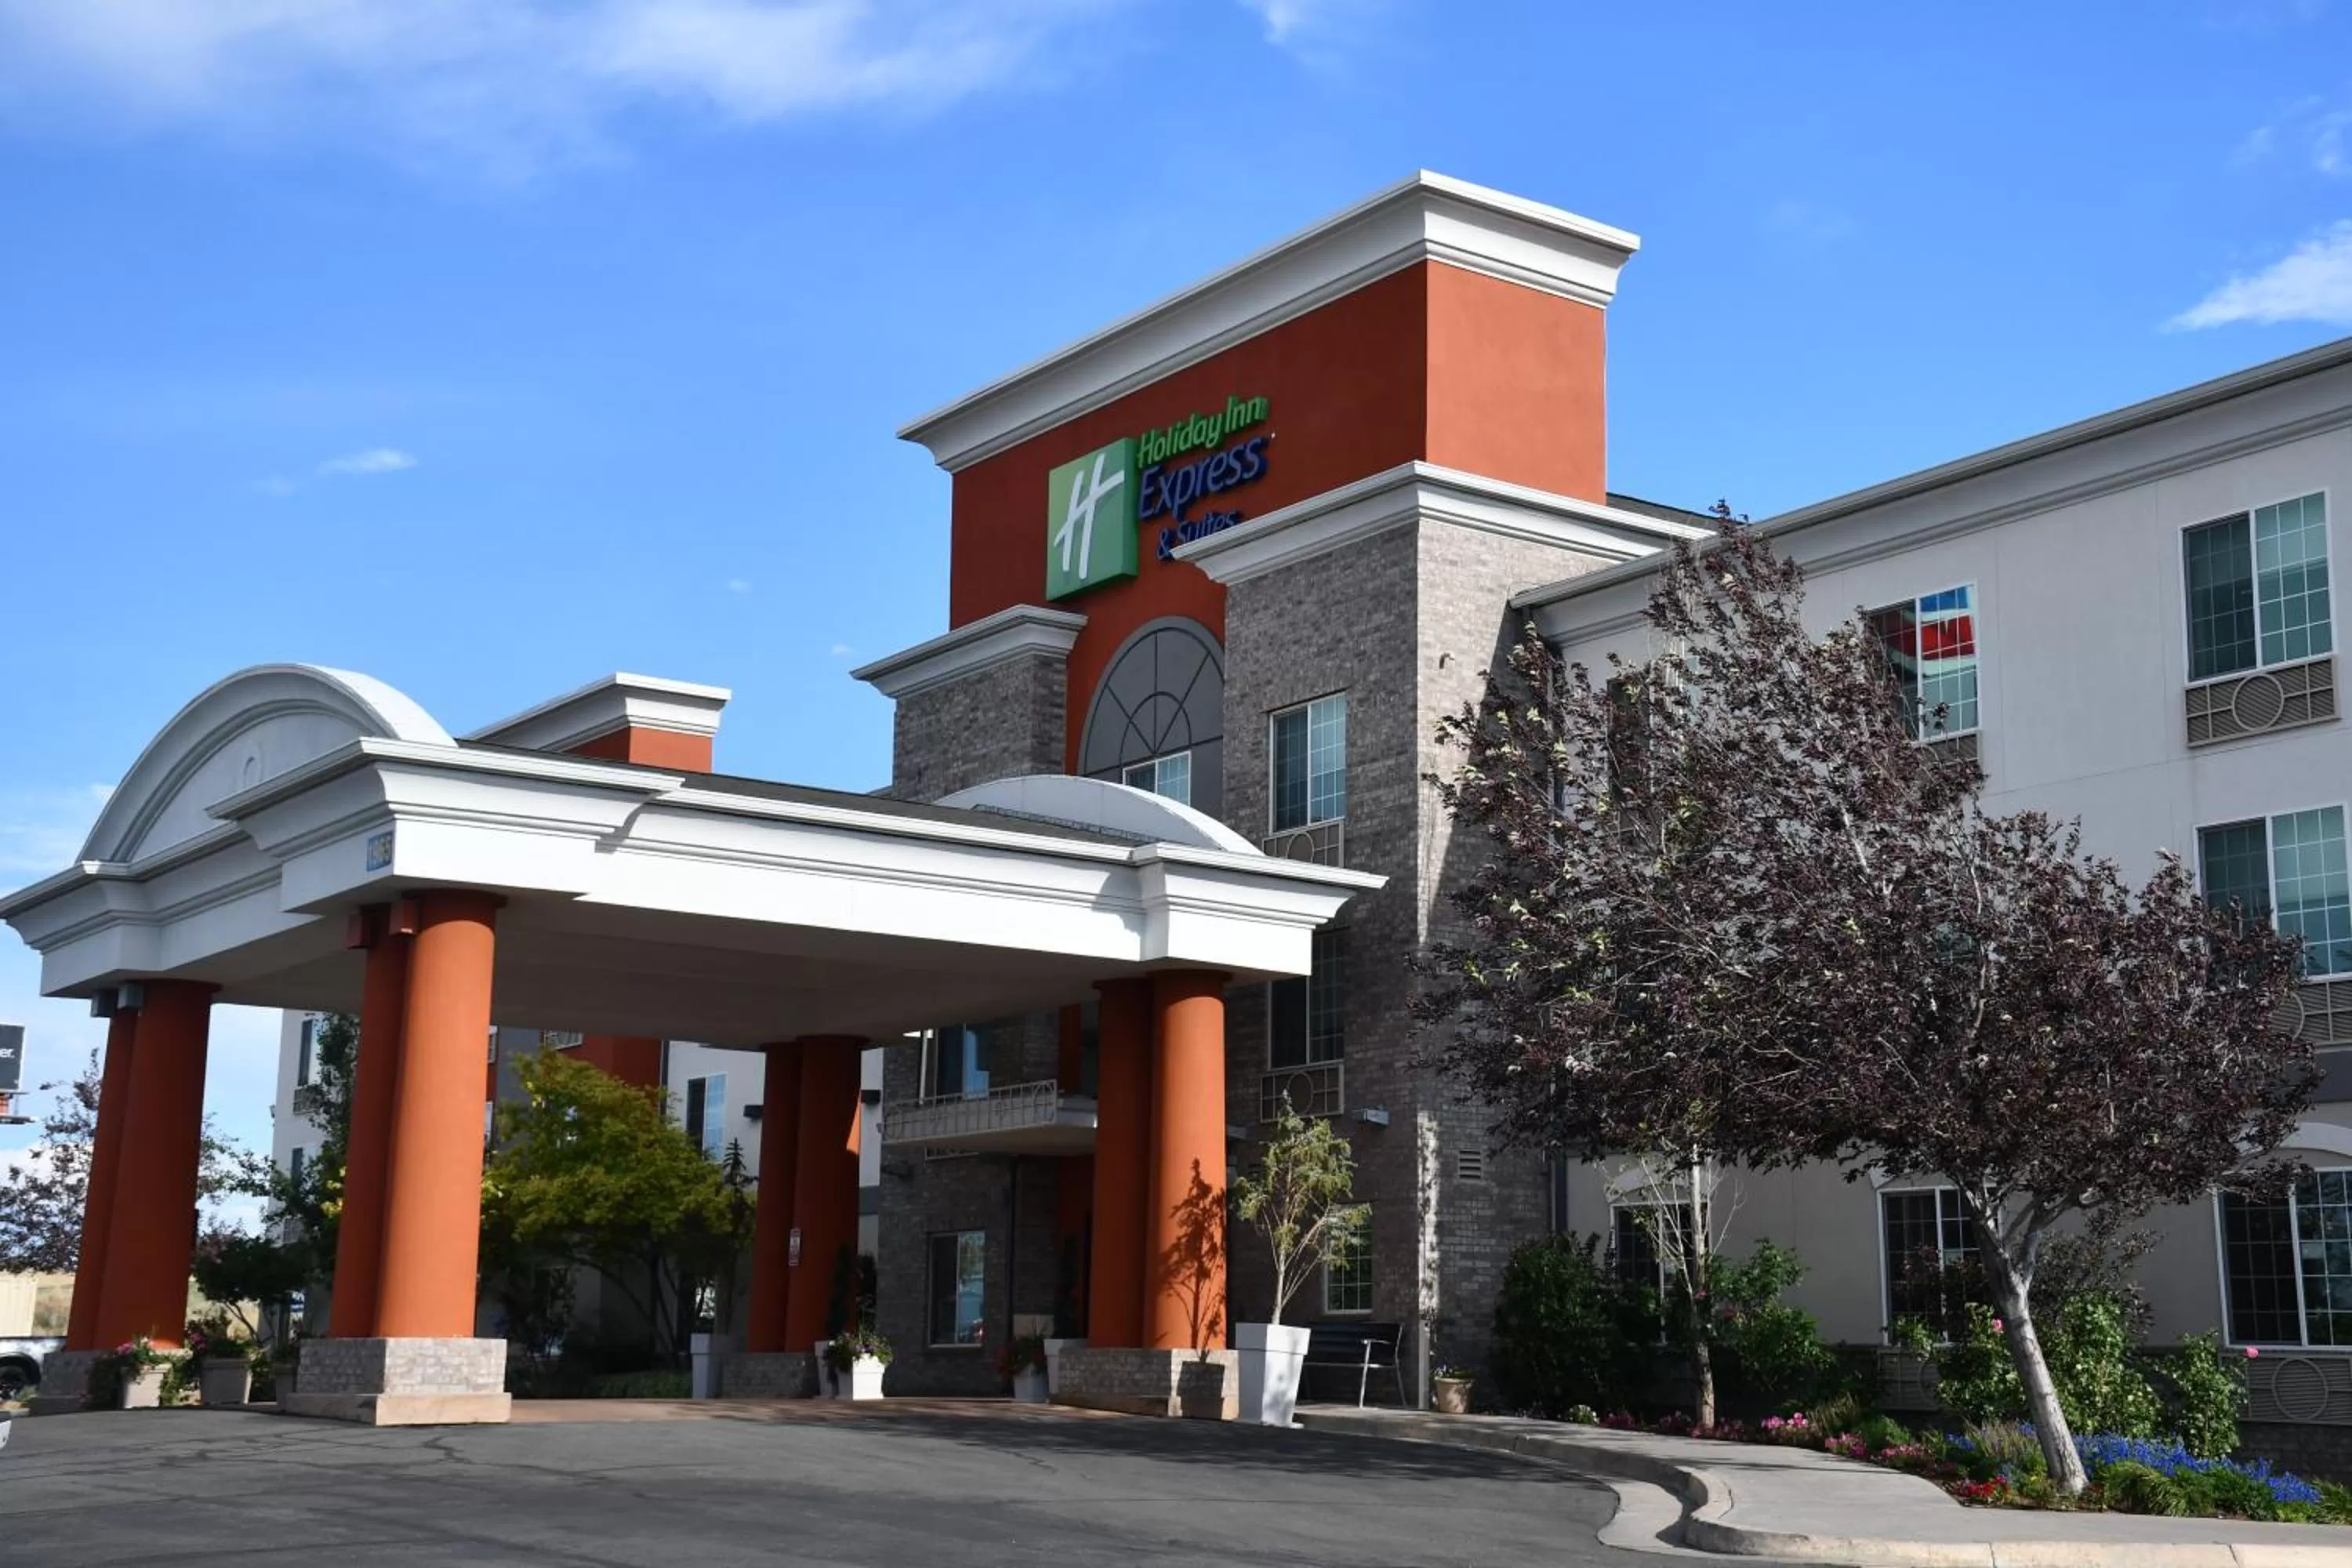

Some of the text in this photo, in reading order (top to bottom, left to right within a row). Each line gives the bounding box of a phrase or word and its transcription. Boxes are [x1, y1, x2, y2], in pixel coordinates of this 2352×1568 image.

[1138, 395, 1268, 469] Holiday Inn
[1138, 437, 1265, 520] Express
[1156, 528, 1171, 560] &
